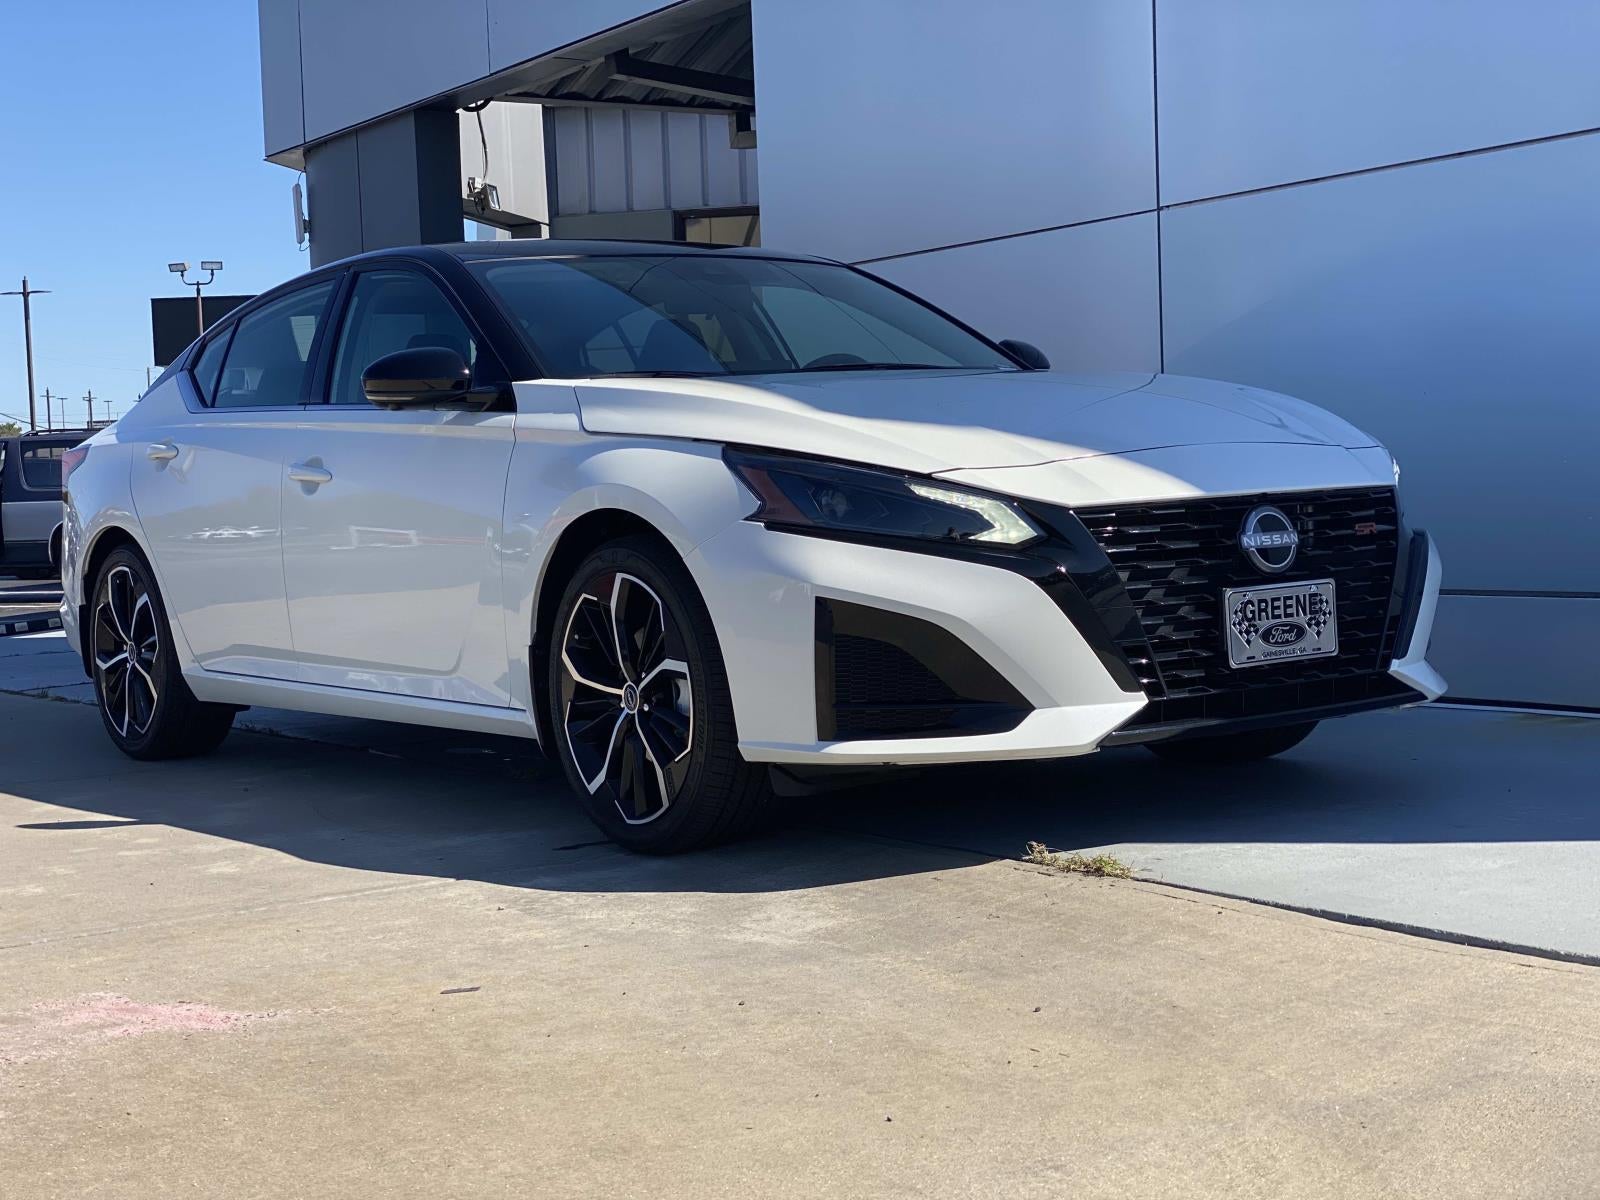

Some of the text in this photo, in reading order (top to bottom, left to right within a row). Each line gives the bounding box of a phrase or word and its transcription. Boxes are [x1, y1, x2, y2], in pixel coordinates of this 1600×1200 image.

[1243, 533, 1298, 547] NISSAN
[1243, 593, 1322, 623] GREENE
[1269, 626, 1296, 643] Ford
